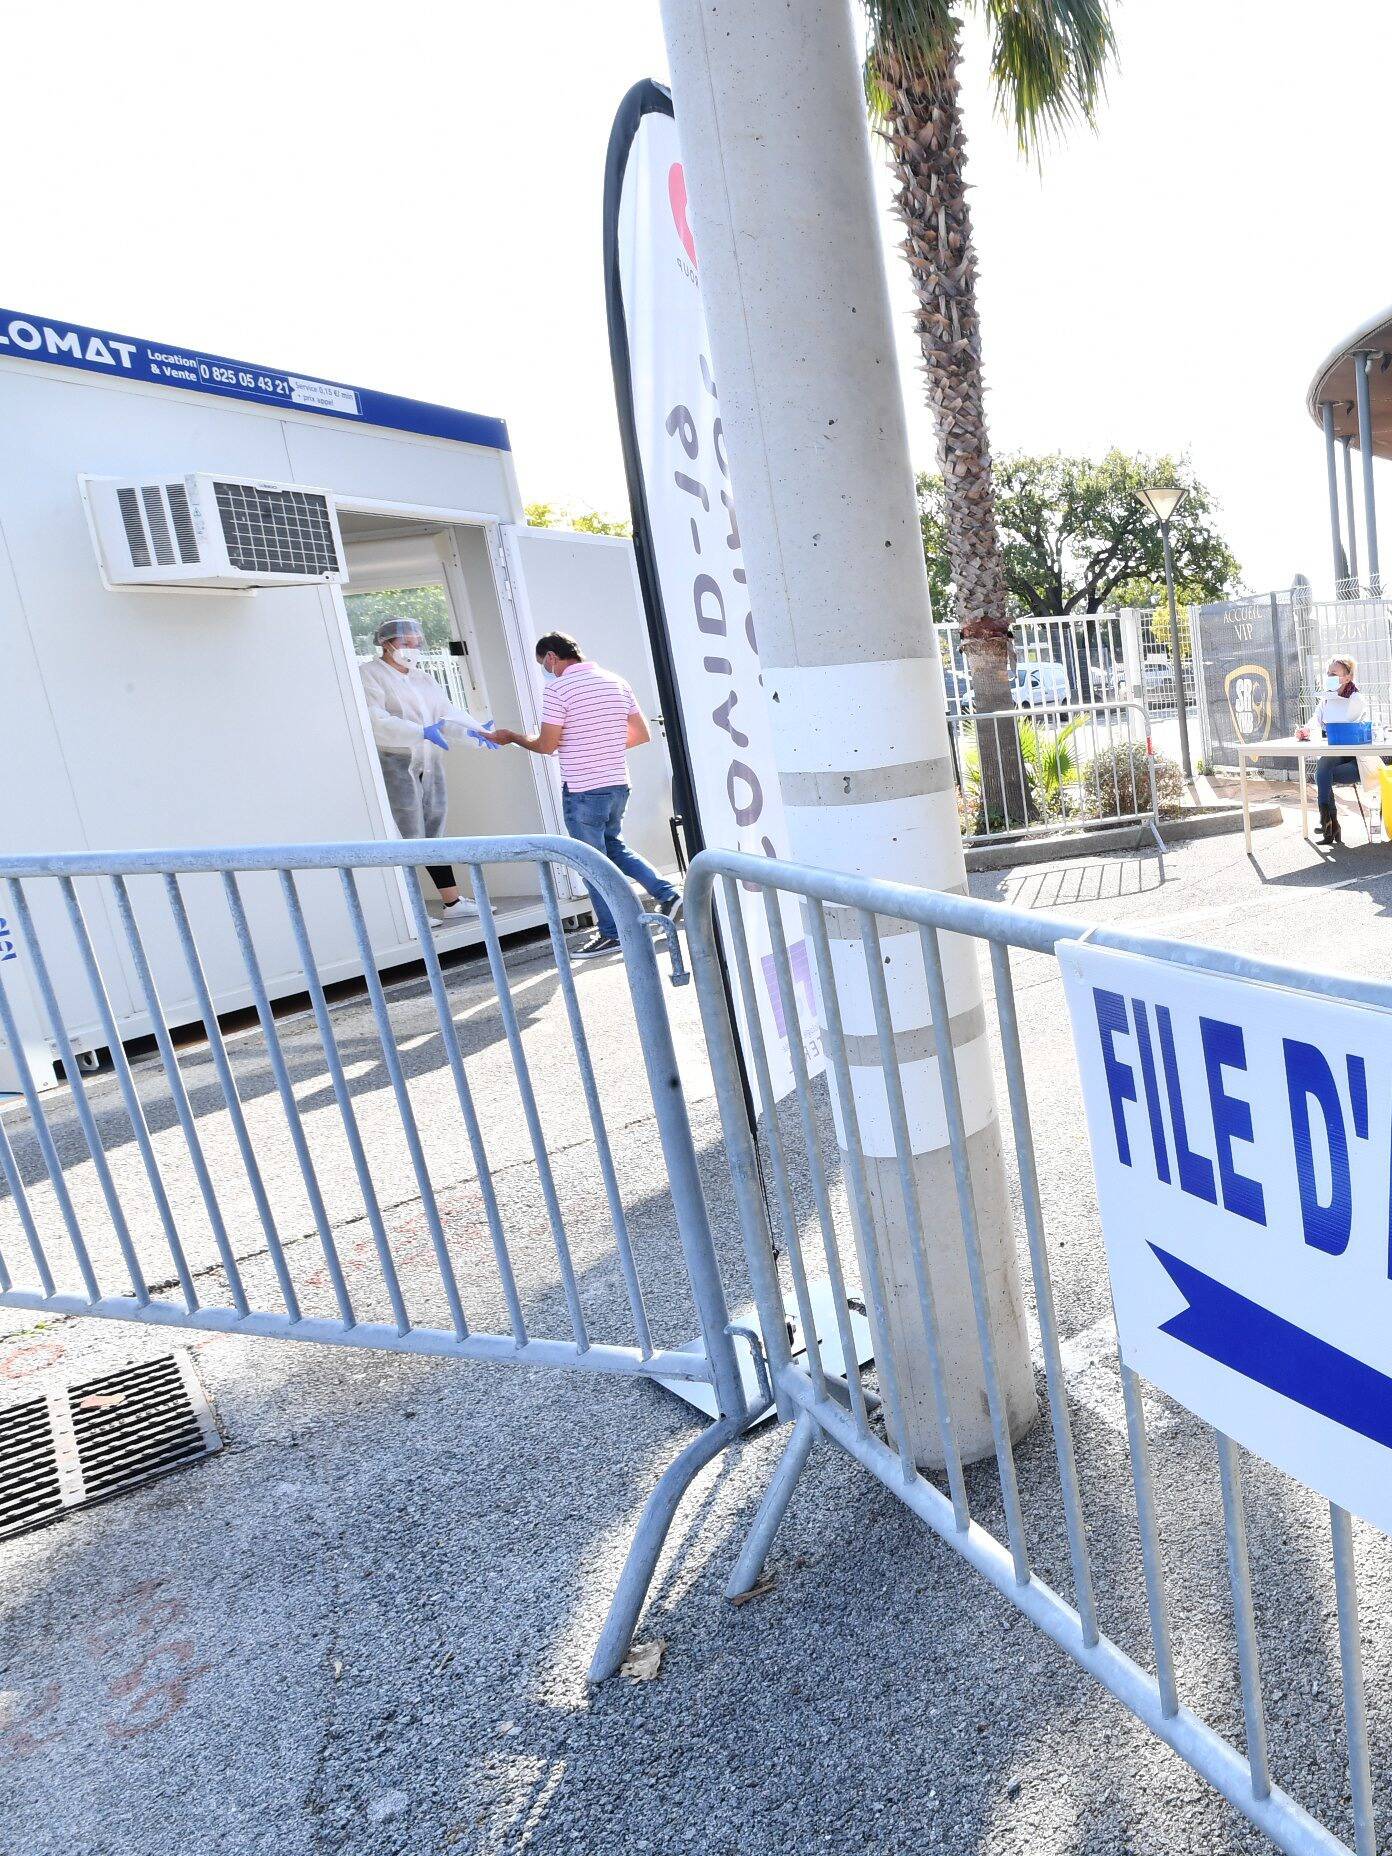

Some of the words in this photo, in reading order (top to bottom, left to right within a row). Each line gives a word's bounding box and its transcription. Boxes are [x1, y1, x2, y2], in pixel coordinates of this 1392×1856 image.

[147, 348, 198, 368] Location
[150, 363, 161, 375] &
[164, 364, 198, 382] Vente
[200, 364, 210, 379] 0
[212, 367, 237, 384] 825
[239, 371, 255, 388] 05
[257, 376, 274, 392] 43
[275, 379, 290, 395] 21
[295, 381, 318, 393] Service
[1223, 604, 1264, 624] ACCUEIL
[1234, 624, 1253, 641] VIP
[1092, 987, 1267, 1227] FILE
